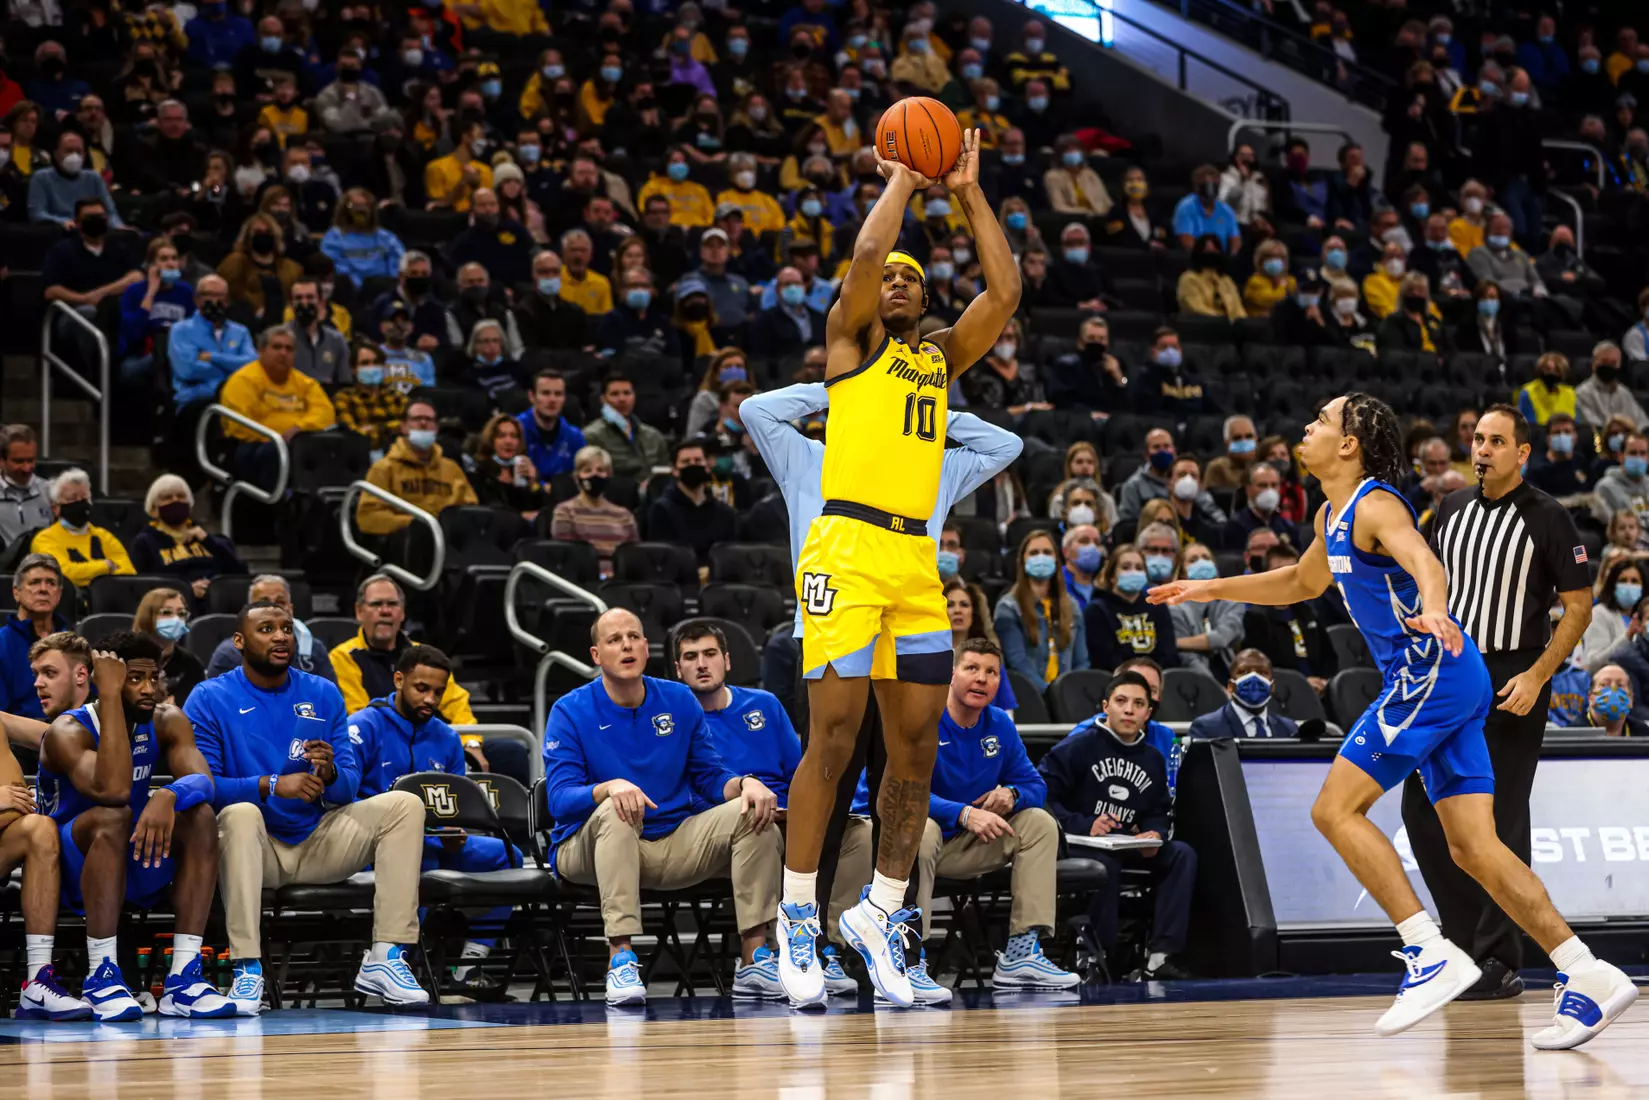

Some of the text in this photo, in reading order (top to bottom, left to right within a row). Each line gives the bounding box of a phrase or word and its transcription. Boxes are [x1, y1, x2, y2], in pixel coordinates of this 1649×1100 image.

[886, 130, 899, 161] LITE
[903, 392, 936, 442] 10
[801, 572, 838, 616] MU
[1091, 757, 1153, 794] CREIGHTON
[420, 784, 459, 818] MU
